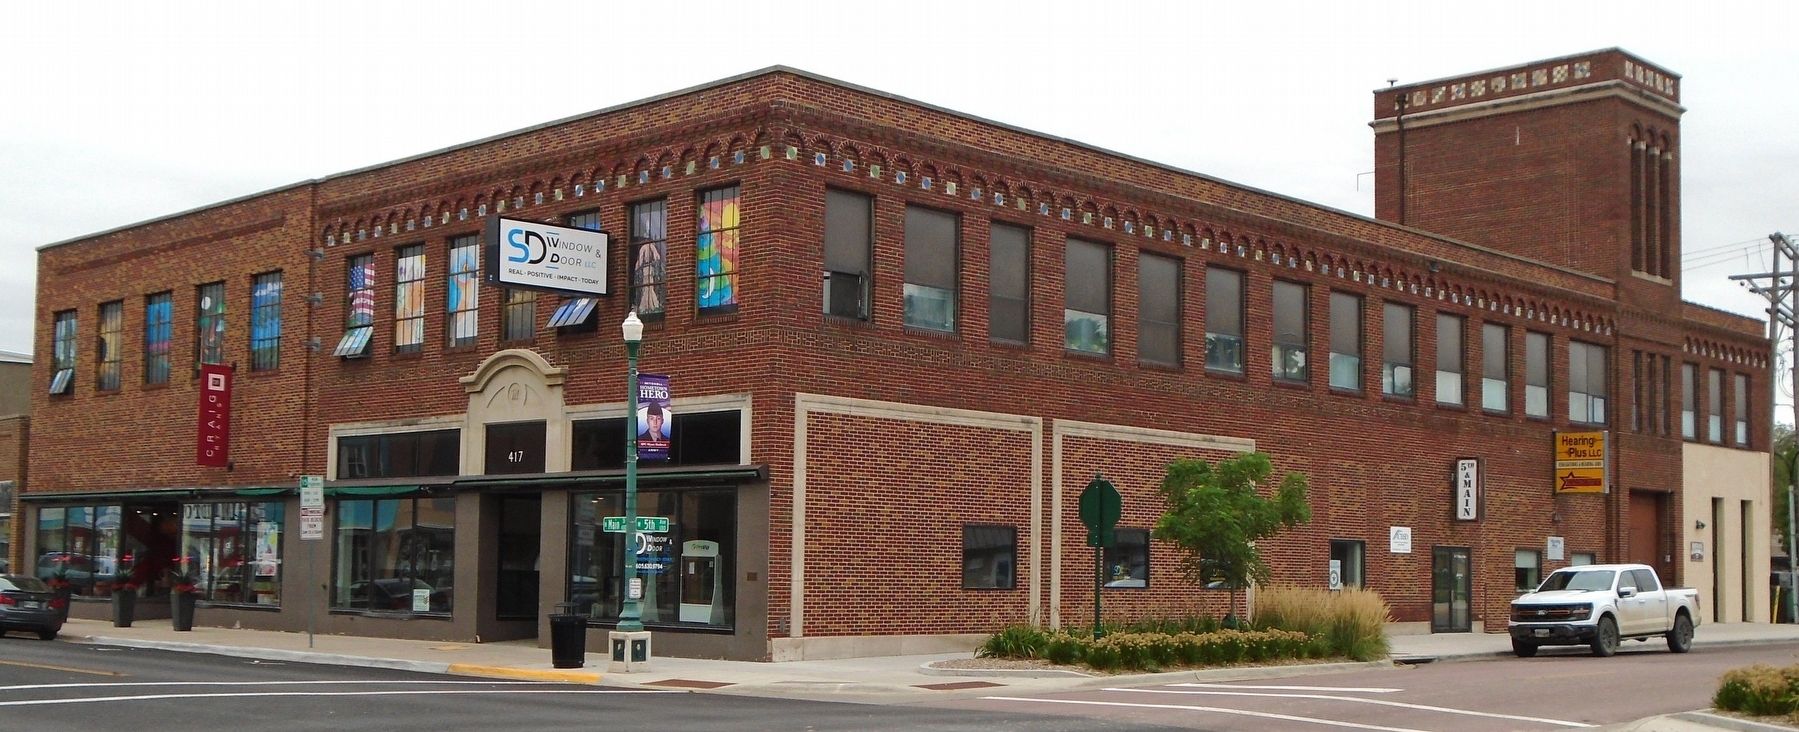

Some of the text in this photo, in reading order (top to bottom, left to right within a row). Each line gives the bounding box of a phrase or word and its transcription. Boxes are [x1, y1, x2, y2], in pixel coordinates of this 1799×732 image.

[508, 228, 547, 265] SD
[546, 236, 601, 259] WINDOW &
[550, 253, 597, 269] DOOR LLC
[508, 268, 599, 286] REAL POSITIVE IMPACT TODAY
[640, 389, 669, 400] HERO
[206, 395, 217, 457] CRAIG
[1561, 435, 1594, 448] Hearing
[508, 450, 524, 463] 417
[1568, 447, 1602, 458] Plus LLC
[1460, 462, 1475, 471] 5TH
[1463, 480, 1472, 517] MAIN
[607, 519, 620, 530] Main
[644, 519, 656, 530] 5th
[645, 535, 668, 543] WINDOW
[647, 544, 663, 552] DOOR
